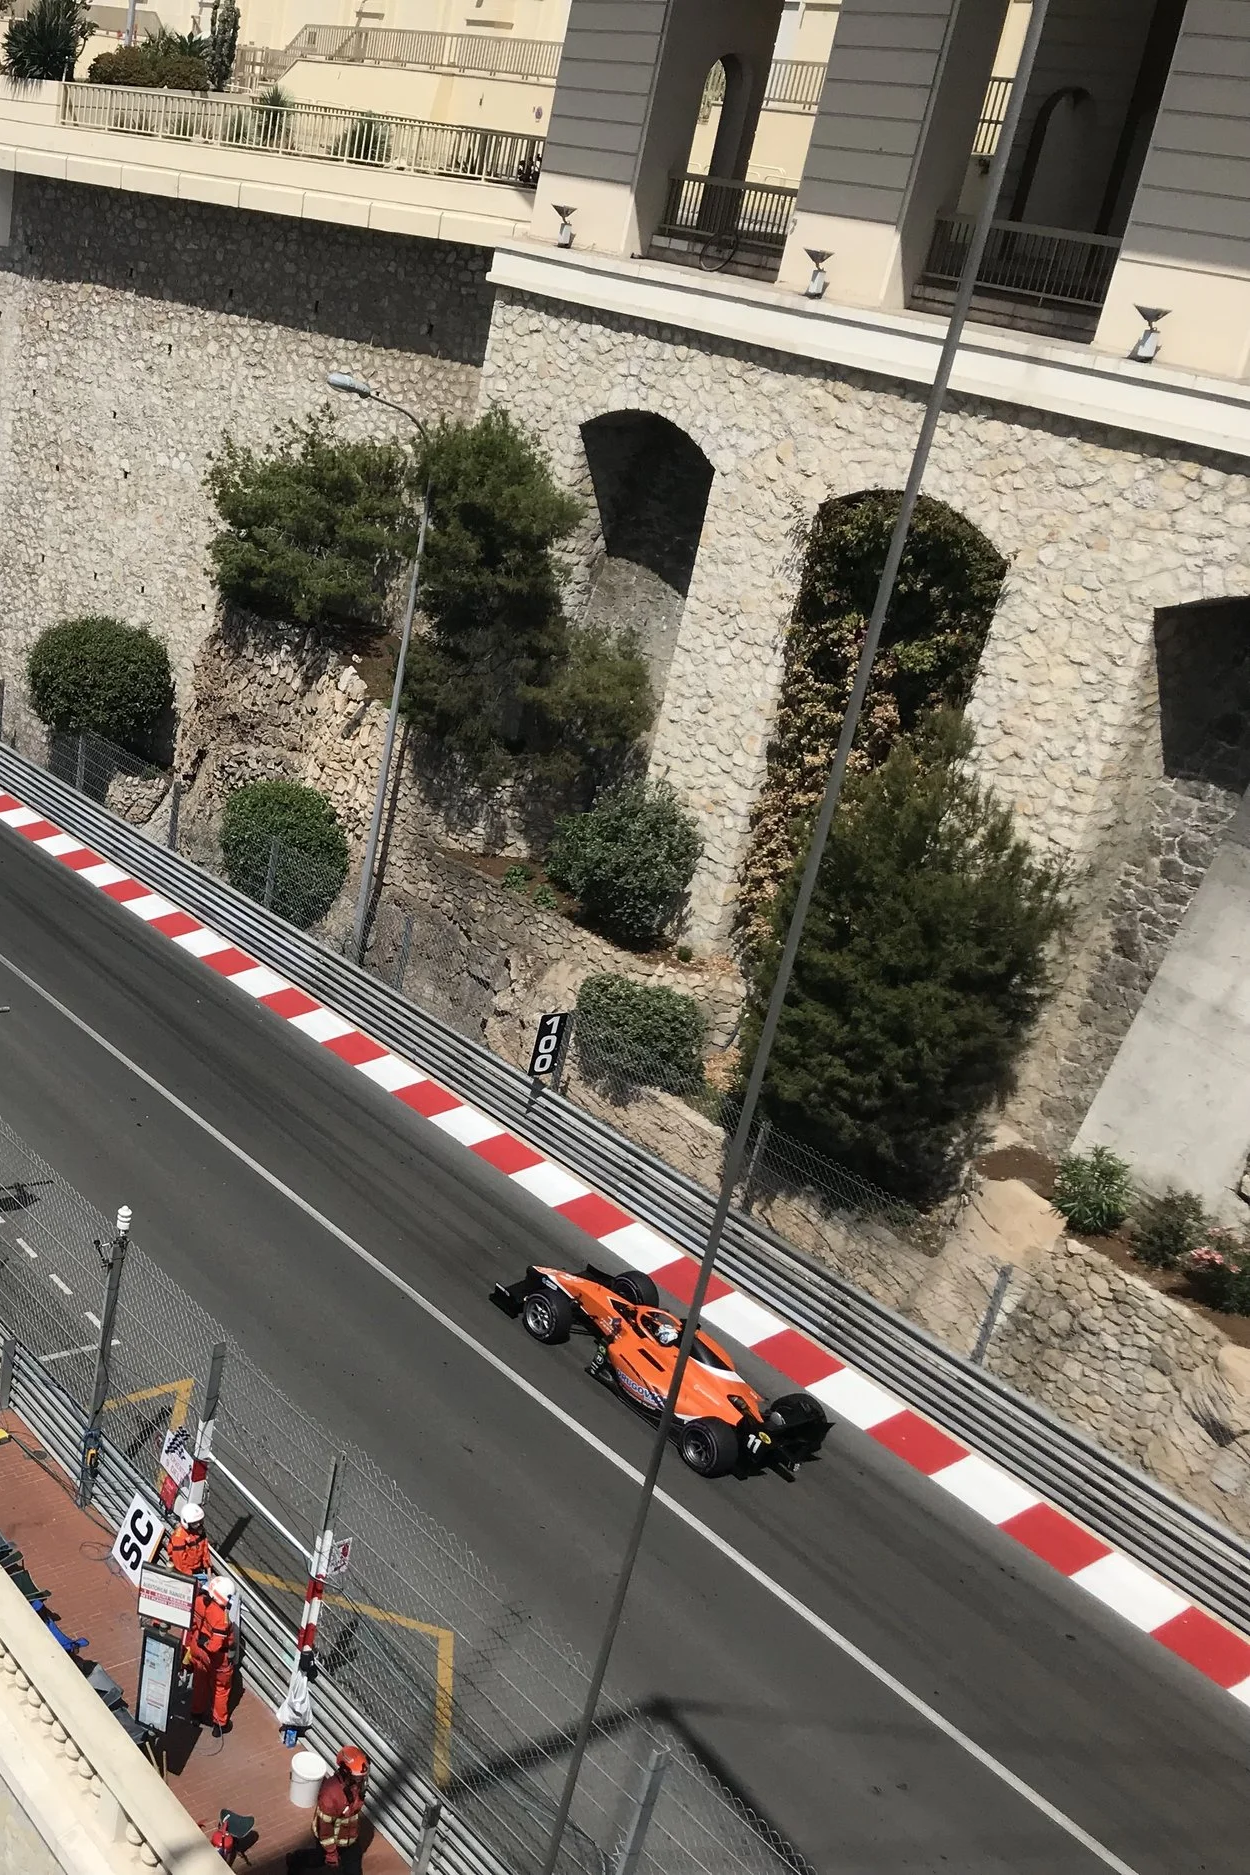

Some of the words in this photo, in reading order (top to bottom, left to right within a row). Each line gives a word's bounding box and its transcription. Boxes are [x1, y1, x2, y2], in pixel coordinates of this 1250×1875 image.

[533, 1015, 561, 1073] 100
[746, 1433, 762, 1454] 11
[119, 1508, 154, 1571] SC
